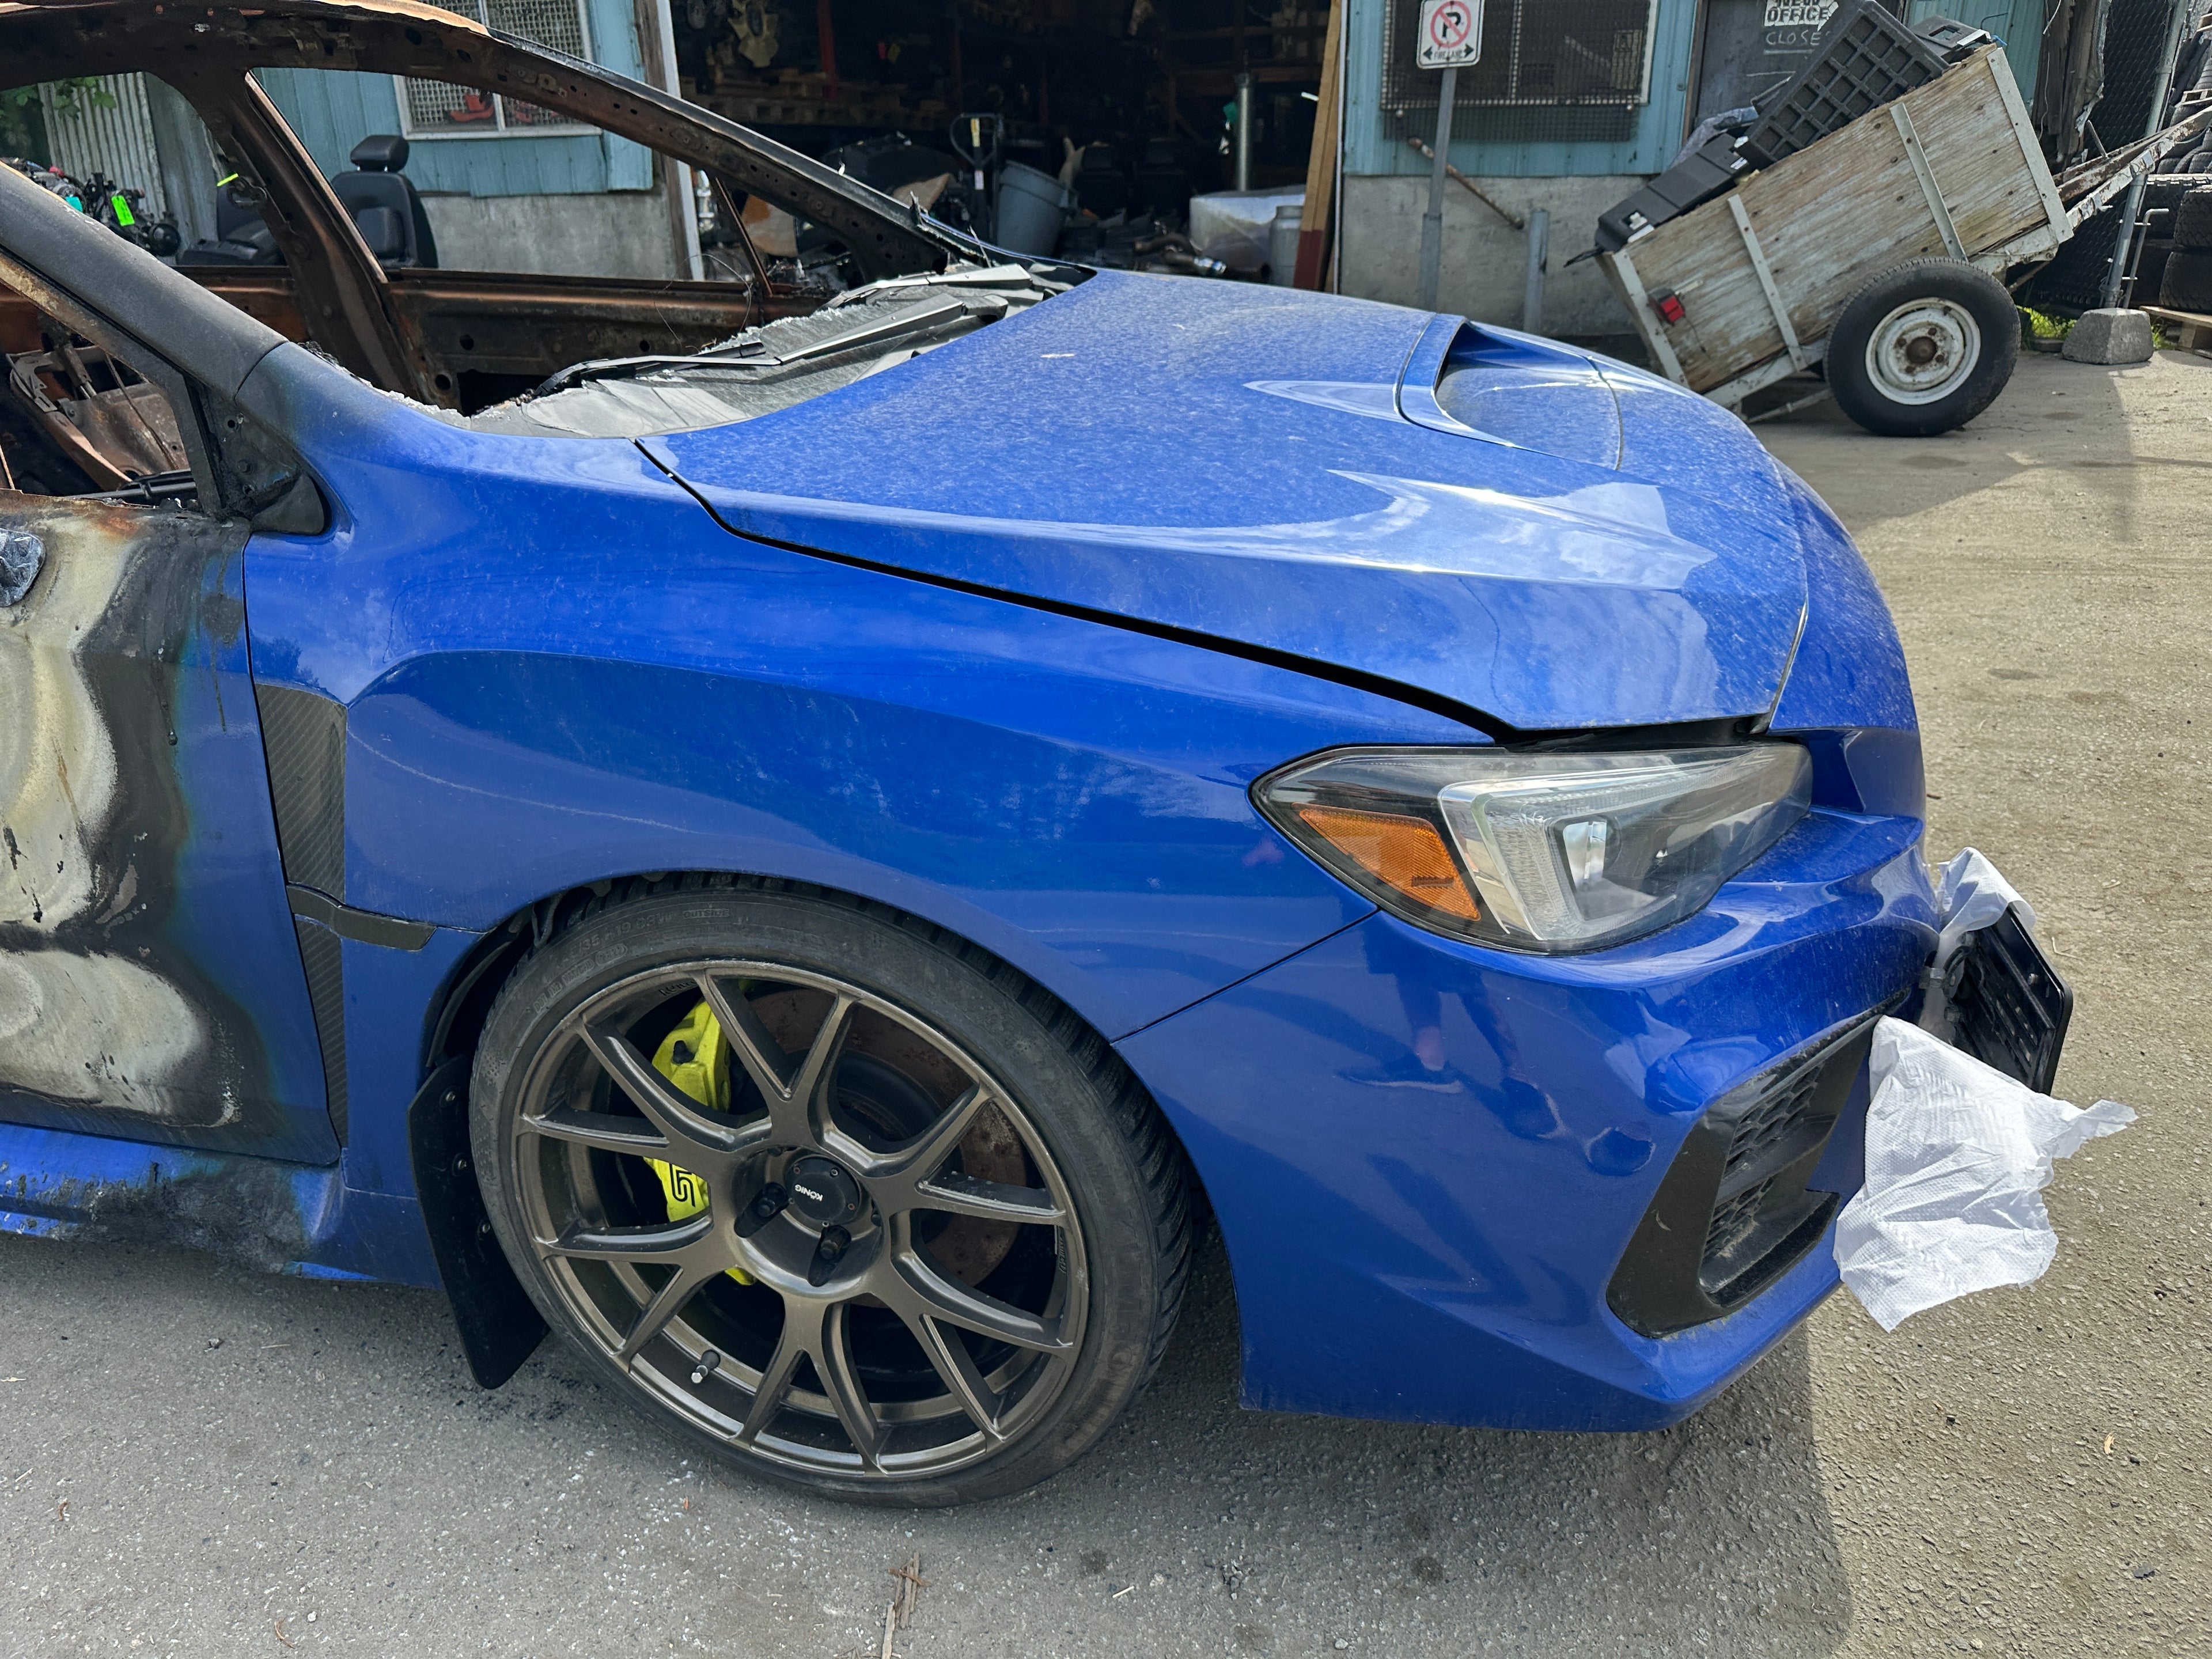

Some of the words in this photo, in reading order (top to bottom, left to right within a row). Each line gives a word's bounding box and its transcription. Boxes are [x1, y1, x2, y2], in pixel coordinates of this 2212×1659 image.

[1767, 6, 1830, 22] OFFICE
[1765, 29, 1831, 46] CLOSE
[683, 908, 729, 919] OUTSIDE
